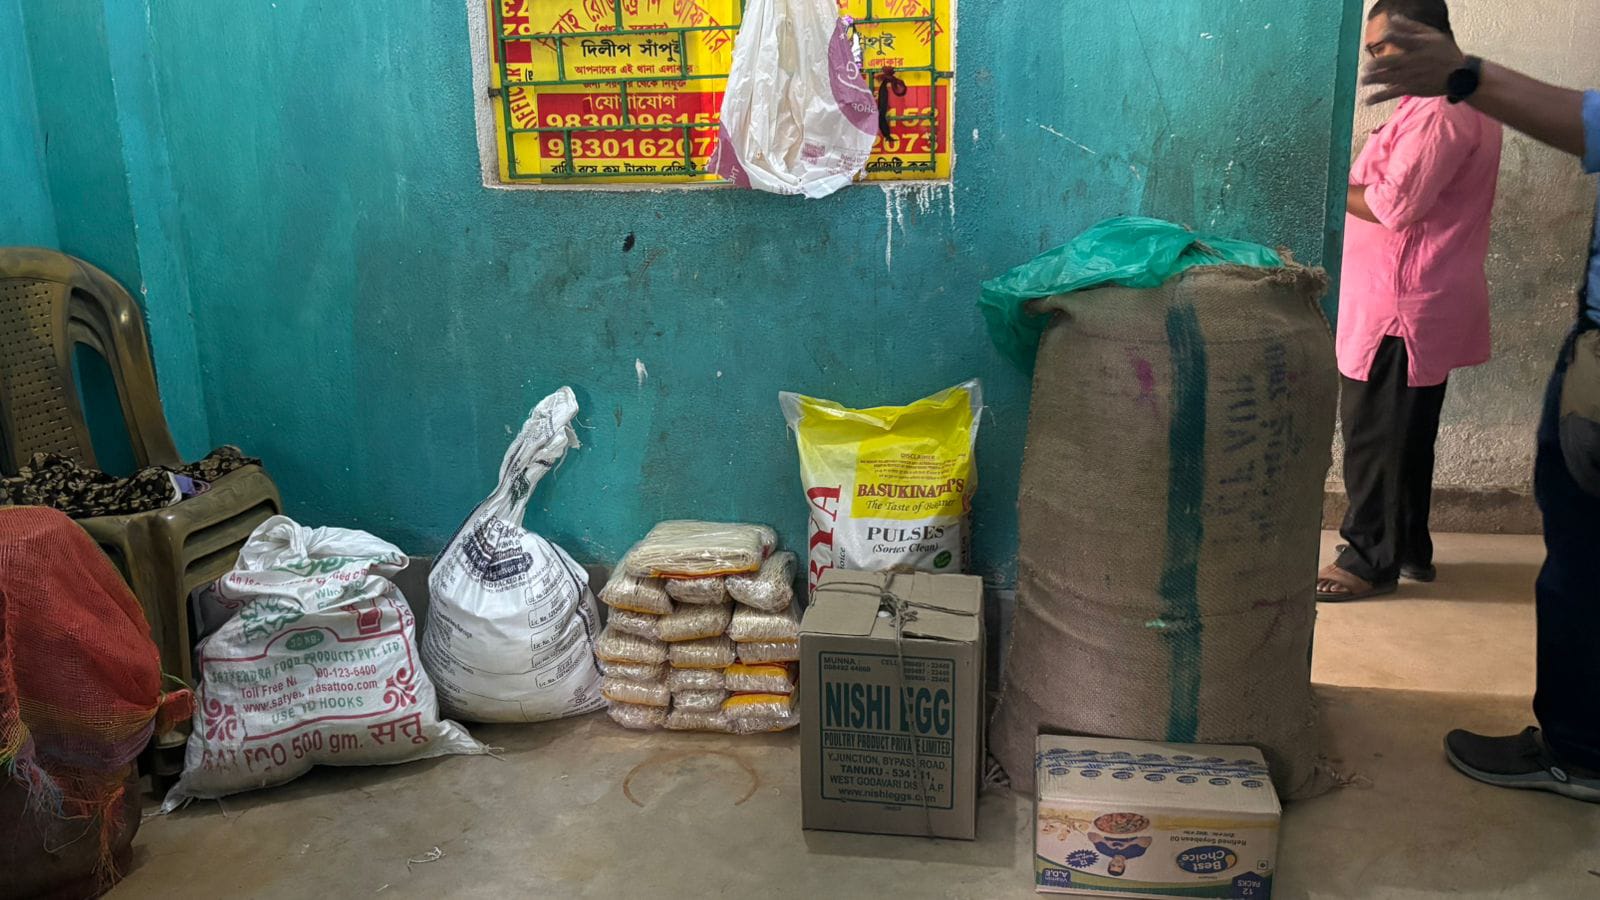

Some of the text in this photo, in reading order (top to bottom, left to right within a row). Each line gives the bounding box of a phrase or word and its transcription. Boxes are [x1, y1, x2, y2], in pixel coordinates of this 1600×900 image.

[581, 39, 631, 58] দিলীপ
[574, 64, 693, 75] আপনাদের এই থানা এলাকর
[548, 138, 719, 157] 983016207
[866, 500, 882, 510] The
[885, 501, 909, 511] Taste
[912, 501, 923, 513] of
[867, 526, 945, 542] PULSES
[873, 543, 939, 554] (Sortex Clean)
[274, 657, 301, 675] FOOD
[304, 650, 355, 664] PRODUCTS
[360, 647, 380, 660] PVT.
[382, 641, 404, 655] LTD.
[823, 657, 857, 666] MUNNA
[241, 687, 259, 699] Toll
[262, 682, 284, 697] Free
[272, 707, 297, 724] USE
[320, 696, 364, 709] HOOKS
[825, 682, 950, 735] NISHI EGG
[368, 712, 429, 745] सत्तू
[292, 729, 323, 760] 500
[329, 732, 363, 753] gm.
[824, 732, 951, 755] POULTRY PRODUCT PRIVAE LIMITED
[841, 765, 883, 776] TANUKU
[892, 768, 910, 778] 534
[830, 775, 855, 785] WEST
[857, 776, 902, 788] GODAVARI
[904, 780, 919, 791] DIS
[1182, 850, 1225, 862] Choice
[1193, 861, 1221, 871] Best
